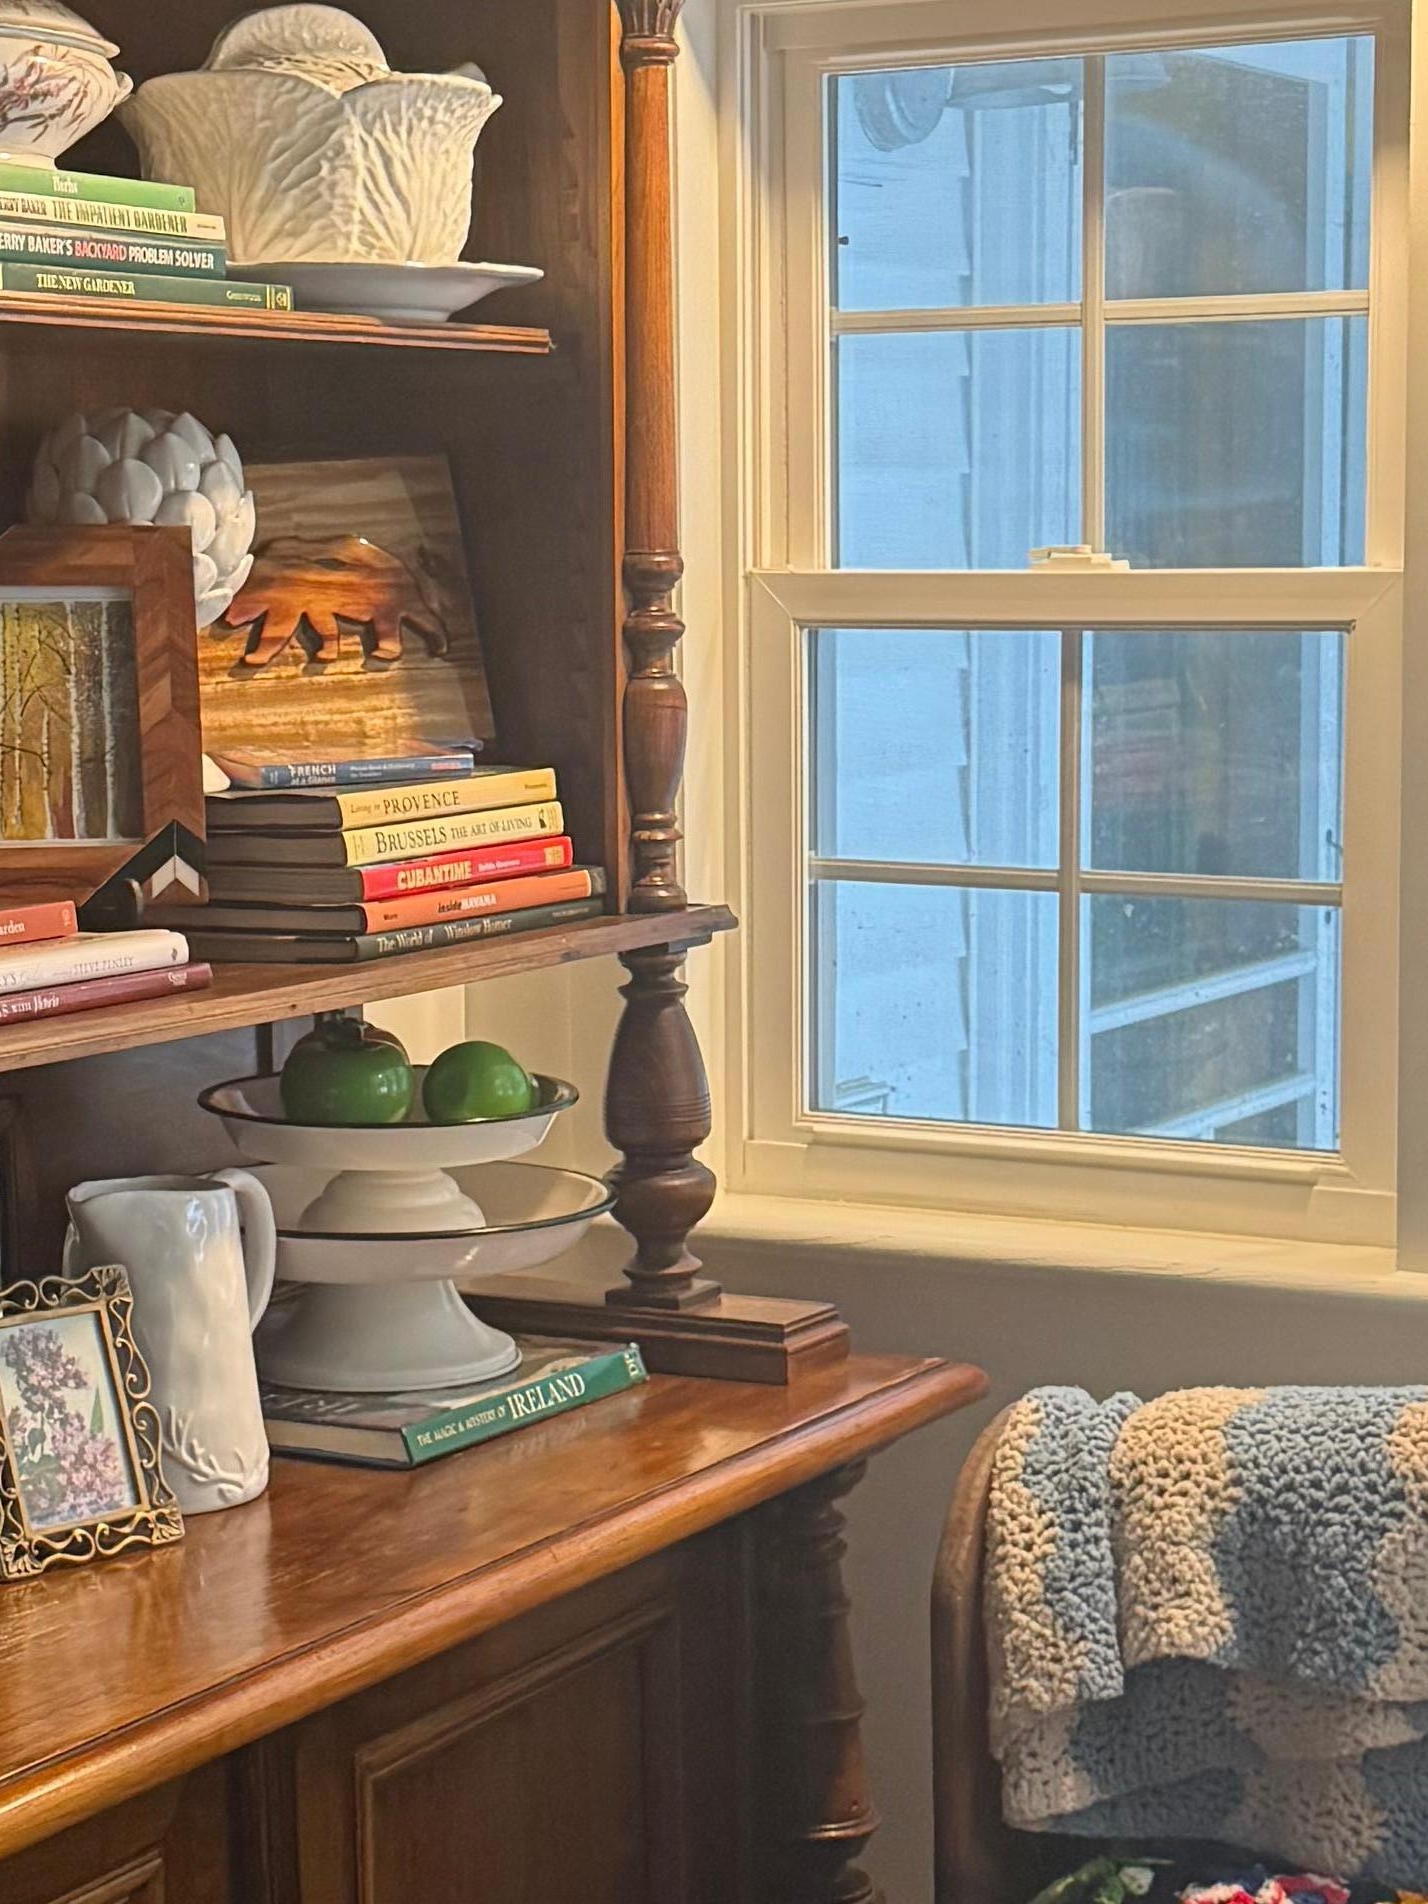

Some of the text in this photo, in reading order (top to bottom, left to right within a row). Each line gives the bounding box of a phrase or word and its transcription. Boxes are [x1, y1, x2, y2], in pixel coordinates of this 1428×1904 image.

[21, 199, 47, 216] BAKER
[52, 200, 72, 219] THE
[76, 203, 131, 227] IMPATIENT
[134, 211, 188, 233] GARDENER
[28, 235, 73, 256] BAKER'S
[74, 240, 127, 262] BACKYARD
[128, 246, 174, 266] PROBLEM
[174, 250, 215, 270] SOLVER
[36, 273, 136, 295] THE NEW GARDENER
[289, 764, 336, 778] FRENCH
[383, 791, 460, 815] PROVENCE
[375, 817, 533, 854] BRUSSELS THE ART OF LIVING
[376, 937, 395, 953] The
[396, 931, 423, 949] World
[424, 929, 434, 945] of
[416, 1434, 432, 1447] THE
[434, 1422, 457, 1439] MAGIC
[506, 1372, 586, 1420] IRELAND
